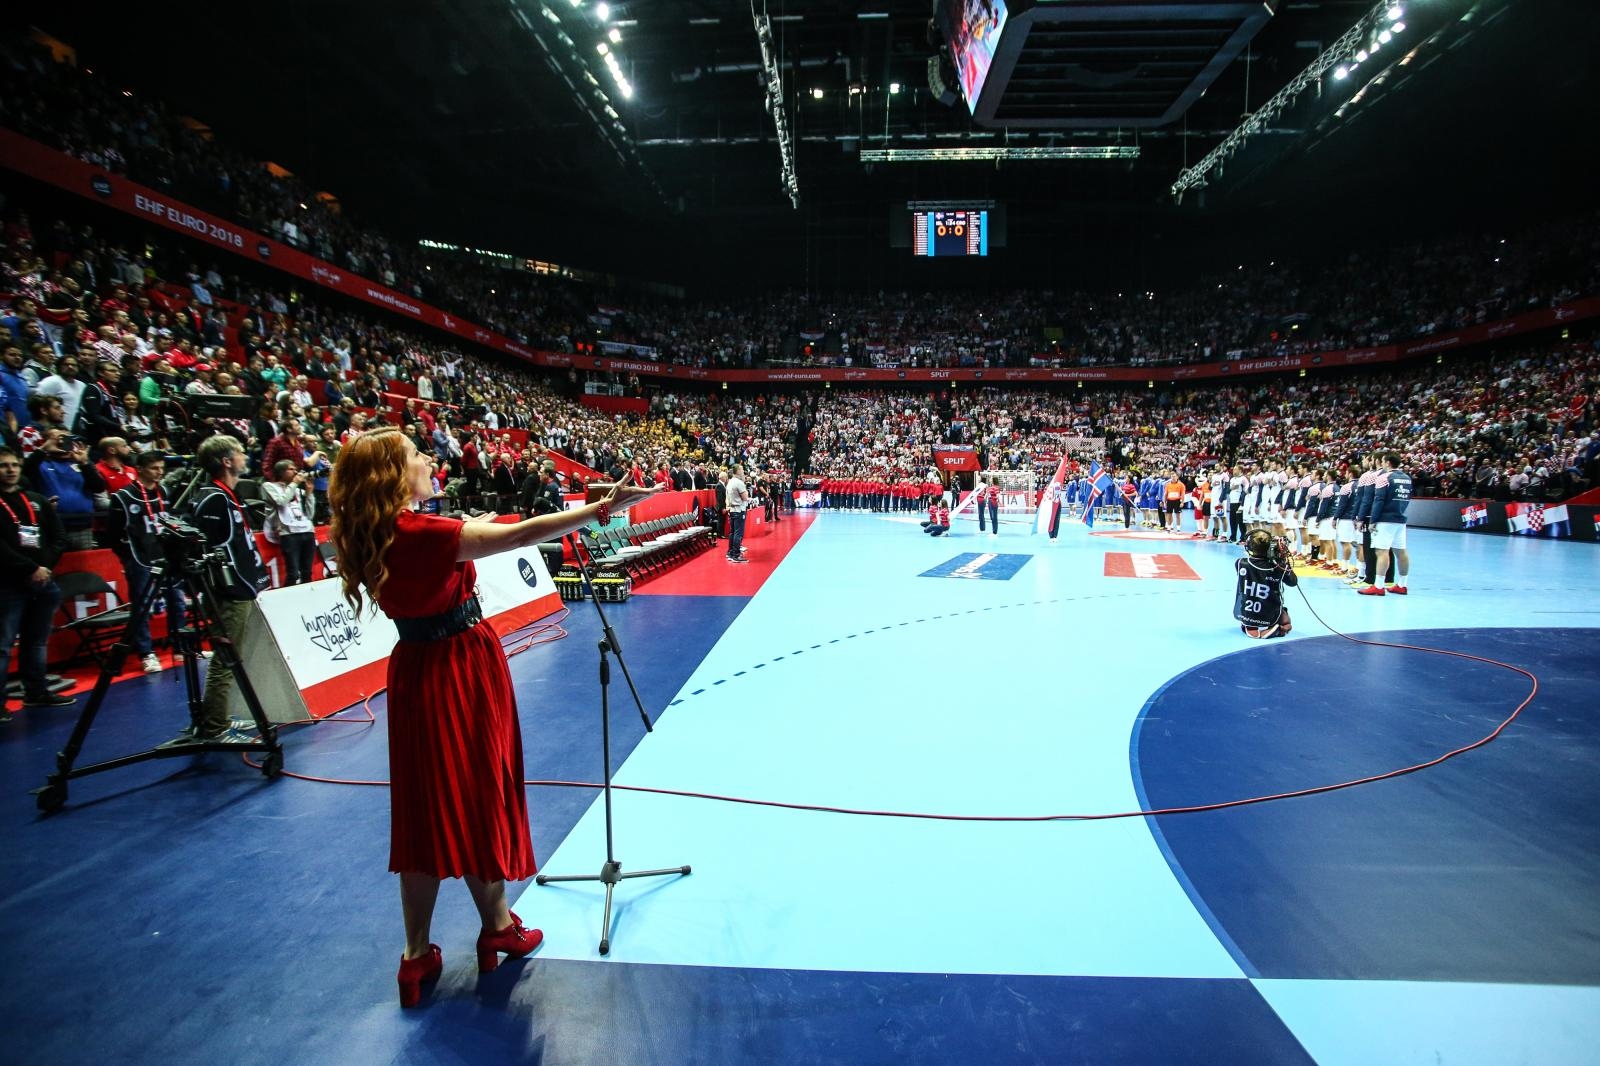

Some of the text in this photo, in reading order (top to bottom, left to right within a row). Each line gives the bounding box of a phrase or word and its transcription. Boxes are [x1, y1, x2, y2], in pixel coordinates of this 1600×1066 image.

[134, 193, 244, 248] EHF EURO 2018
[938, 226, 946, 236] 0
[954, 226, 963, 236] 0
[623, 362, 642, 370] EURO
[642, 364, 660, 372] 2018
[943, 457, 966, 465] SPLIT
[521, 564, 533, 578] EHF
[1243, 579, 1270, 600] HB
[1244, 599, 1262, 613] 20
[300, 602, 354, 652] hypnotic
[330, 625, 363, 661] game
